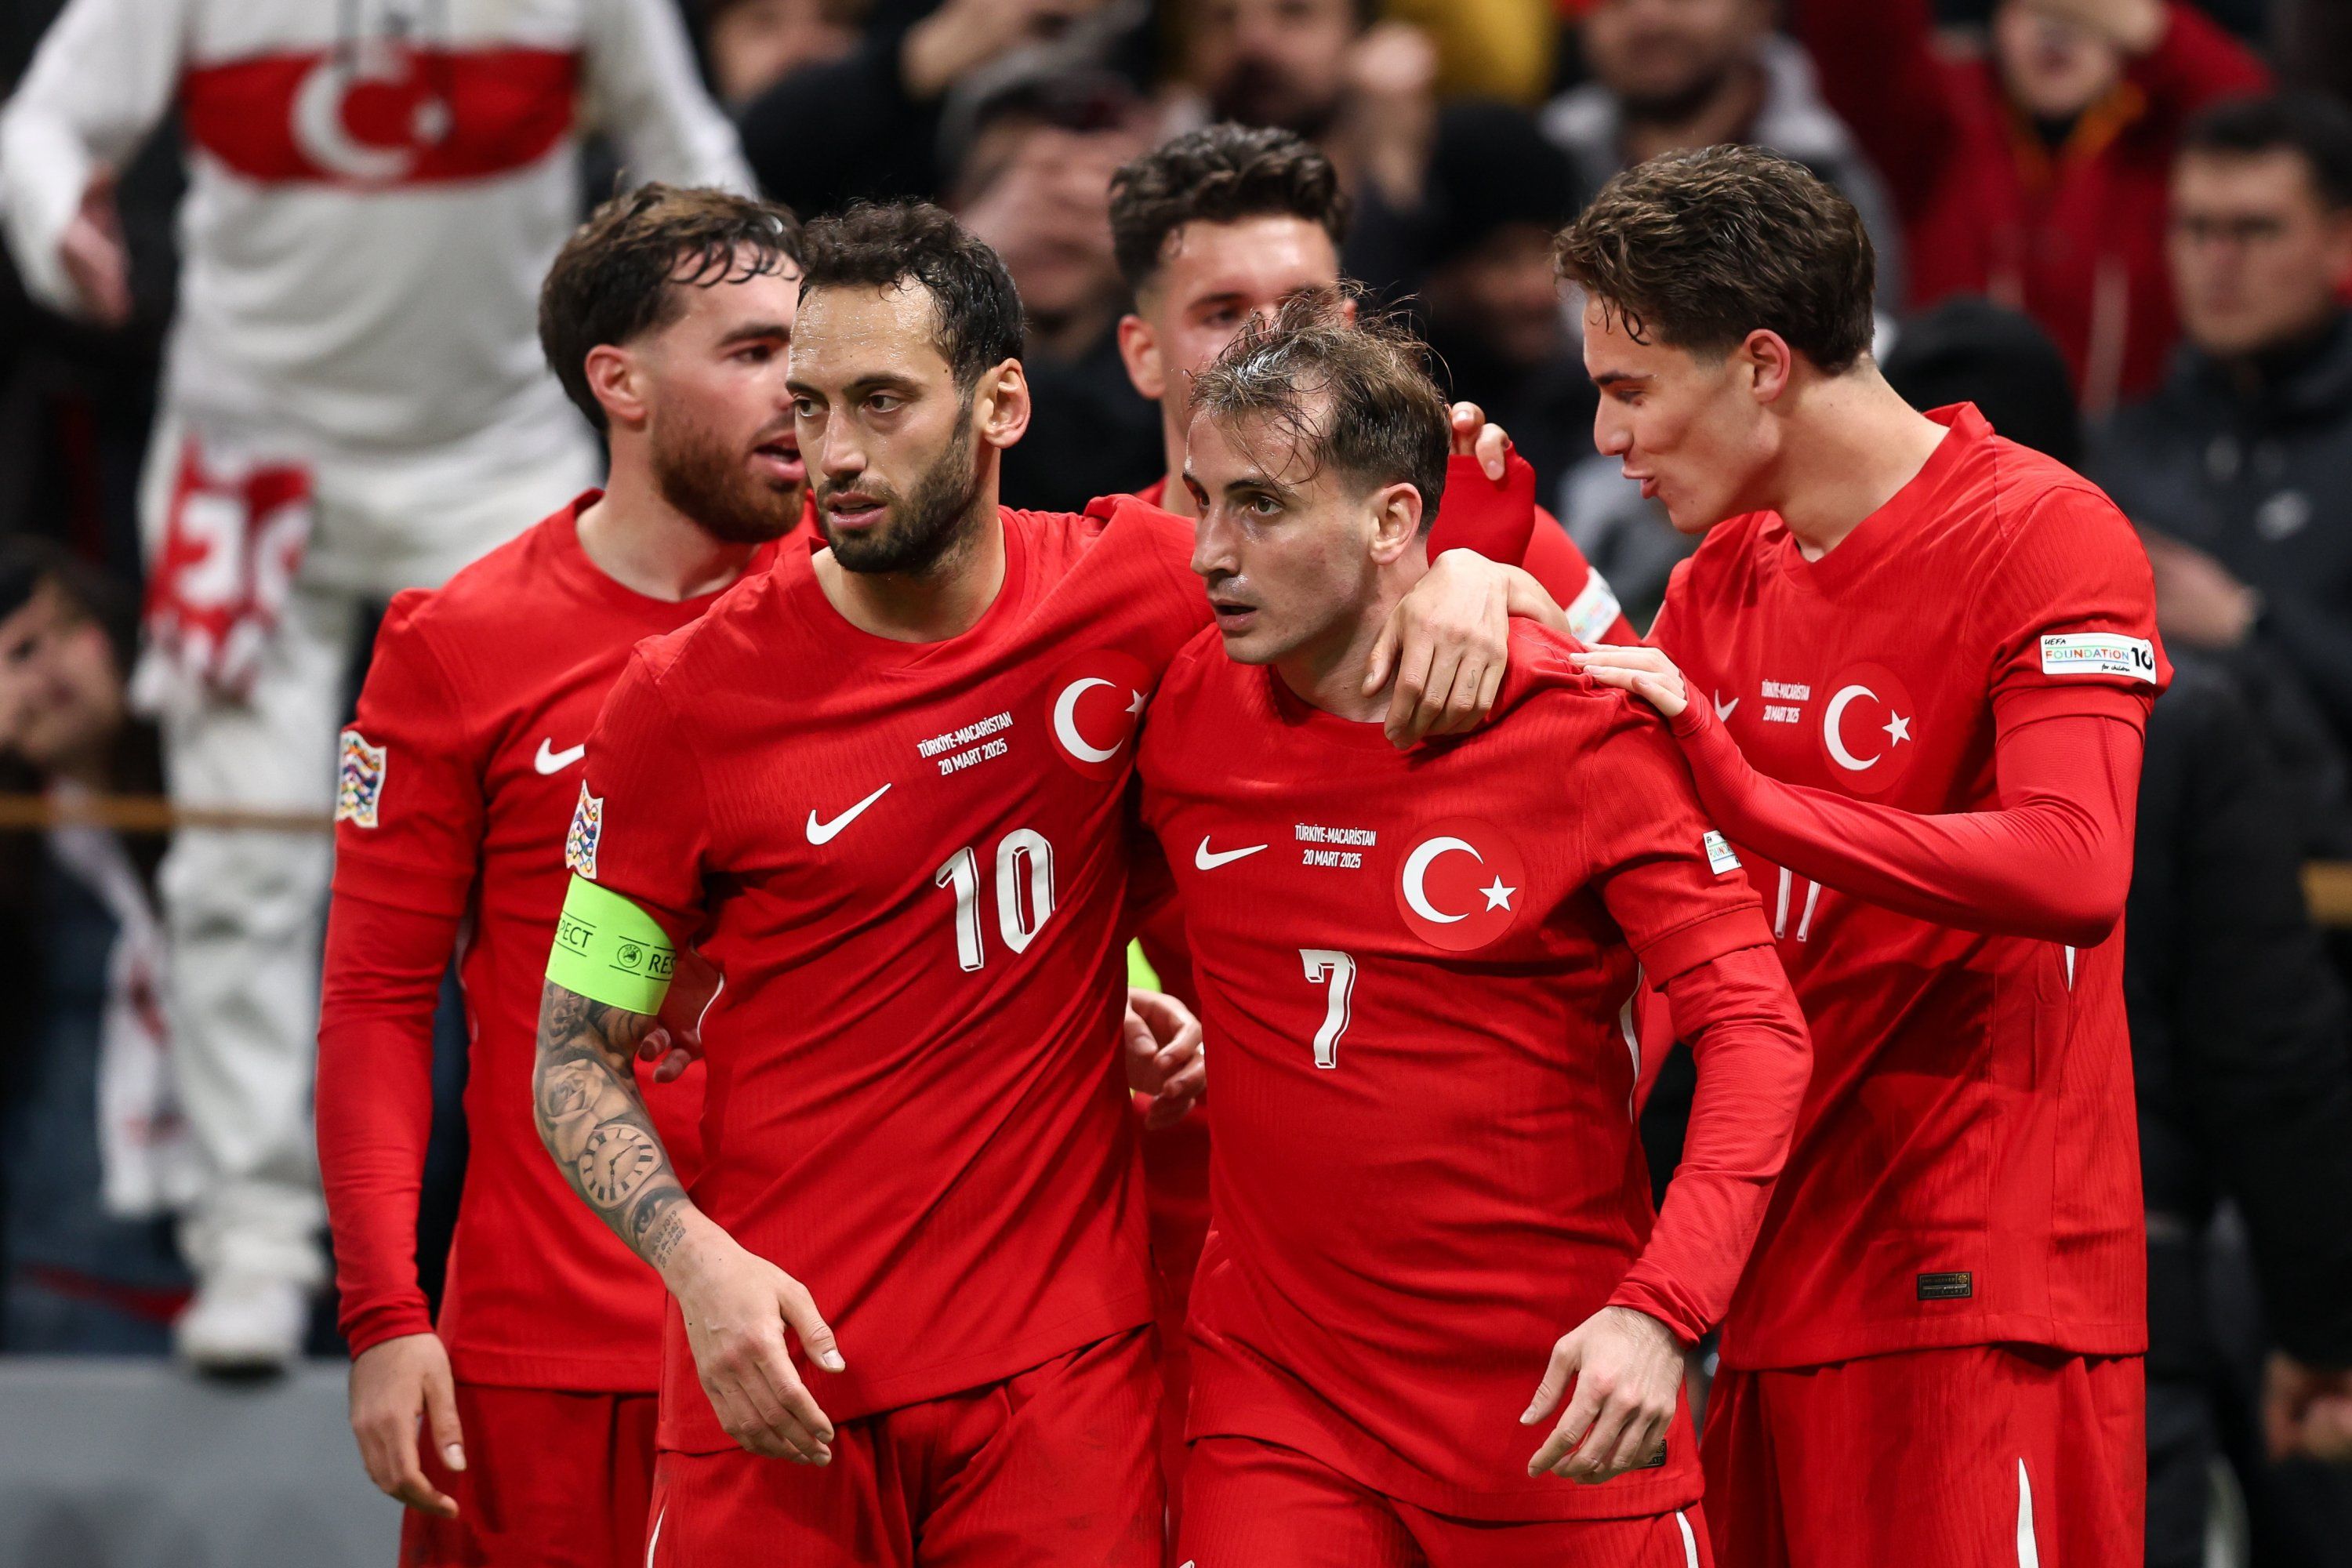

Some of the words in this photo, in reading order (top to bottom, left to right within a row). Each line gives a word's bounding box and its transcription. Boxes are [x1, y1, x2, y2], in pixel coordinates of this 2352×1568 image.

[916, 711, 1014, 759] TÜRKİYE-MACARİSTAN
[938, 758, 954, 776] 20
[951, 747, 983, 771] MART
[981, 738, 1007, 760] 2025
[1294, 822, 1376, 846] TÜRKİYE-MACARİSTAN
[1302, 849, 1314, 866] 20
[1314, 851, 1341, 867] MART
[1339, 852, 1363, 869] 2025
[935, 828, 1057, 973] 10
[1298, 949, 1357, 1069] 7
